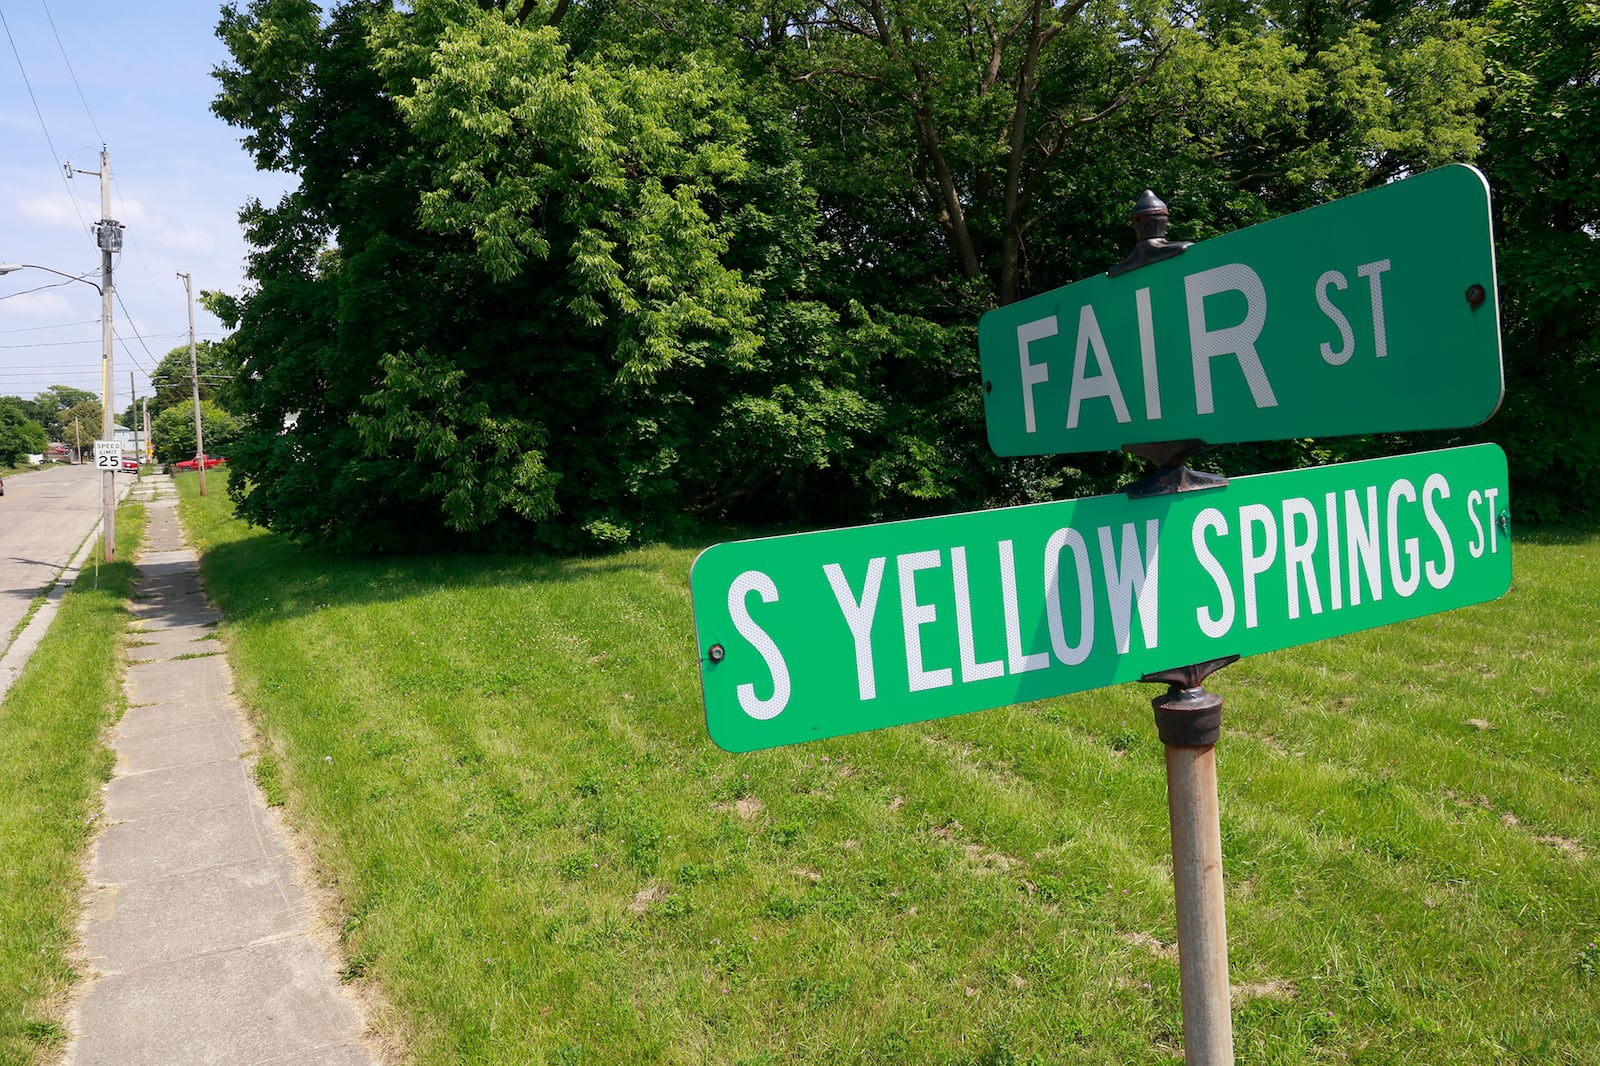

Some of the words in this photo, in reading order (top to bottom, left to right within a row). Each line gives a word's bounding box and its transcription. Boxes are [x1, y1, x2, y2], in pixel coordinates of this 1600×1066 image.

[1017, 263, 1278, 433] FAIR
[1315, 258, 1391, 366] ST
[99, 456, 119, 466] 25
[727, 570, 791, 721] S
[822, 518, 1159, 701] YELLOW
[1191, 473, 1455, 639] SPRINGS
[1467, 487, 1499, 559] ST
